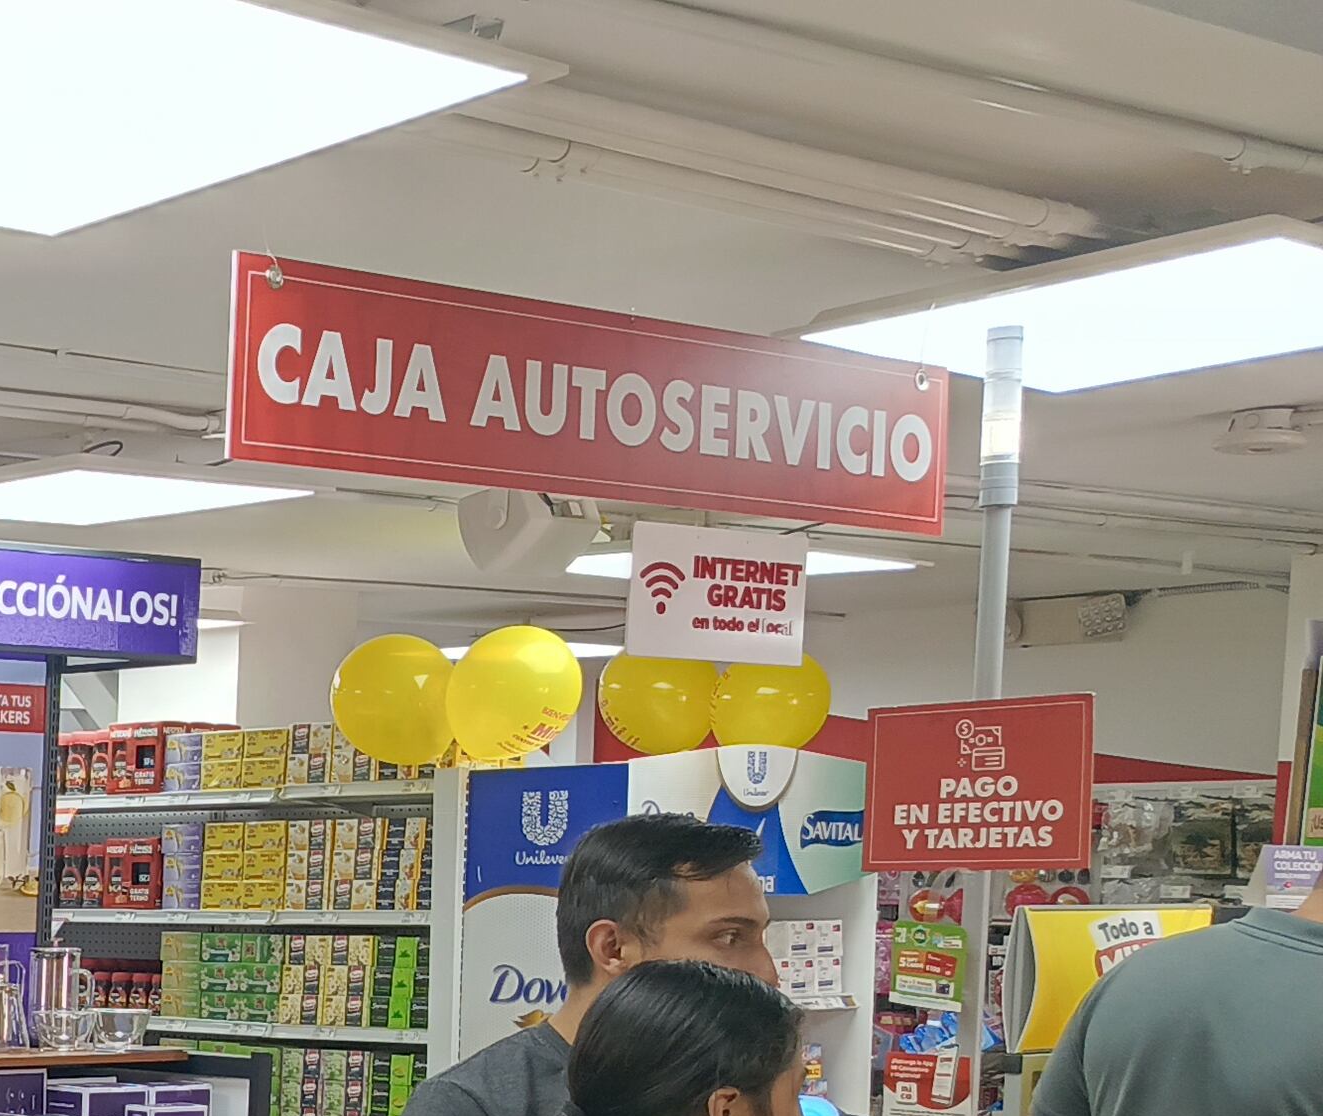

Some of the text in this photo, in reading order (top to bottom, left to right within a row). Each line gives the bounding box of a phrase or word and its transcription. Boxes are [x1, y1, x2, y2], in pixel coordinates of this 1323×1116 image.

[257, 322, 933, 484] CAJA AUTOSERVICIO
[693, 555, 803, 587] INTERNET
[707, 583, 786, 612] GRATIS
[692, 616, 709, 630] en
[712, 615, 744, 632] todo
[748, 618, 760, 633] el
[11, 694, 32, 708] TUS
[939, 775, 1019, 799] PAGO
[893, 798, 1064, 826] EN EFECTIVO
[802, 814, 863, 841] SAVITAL
[902, 825, 1054, 850] Y TARJETAS
[1274, 849, 1318, 862] ARMA TU
[1097, 916, 1154, 943] Todo a
